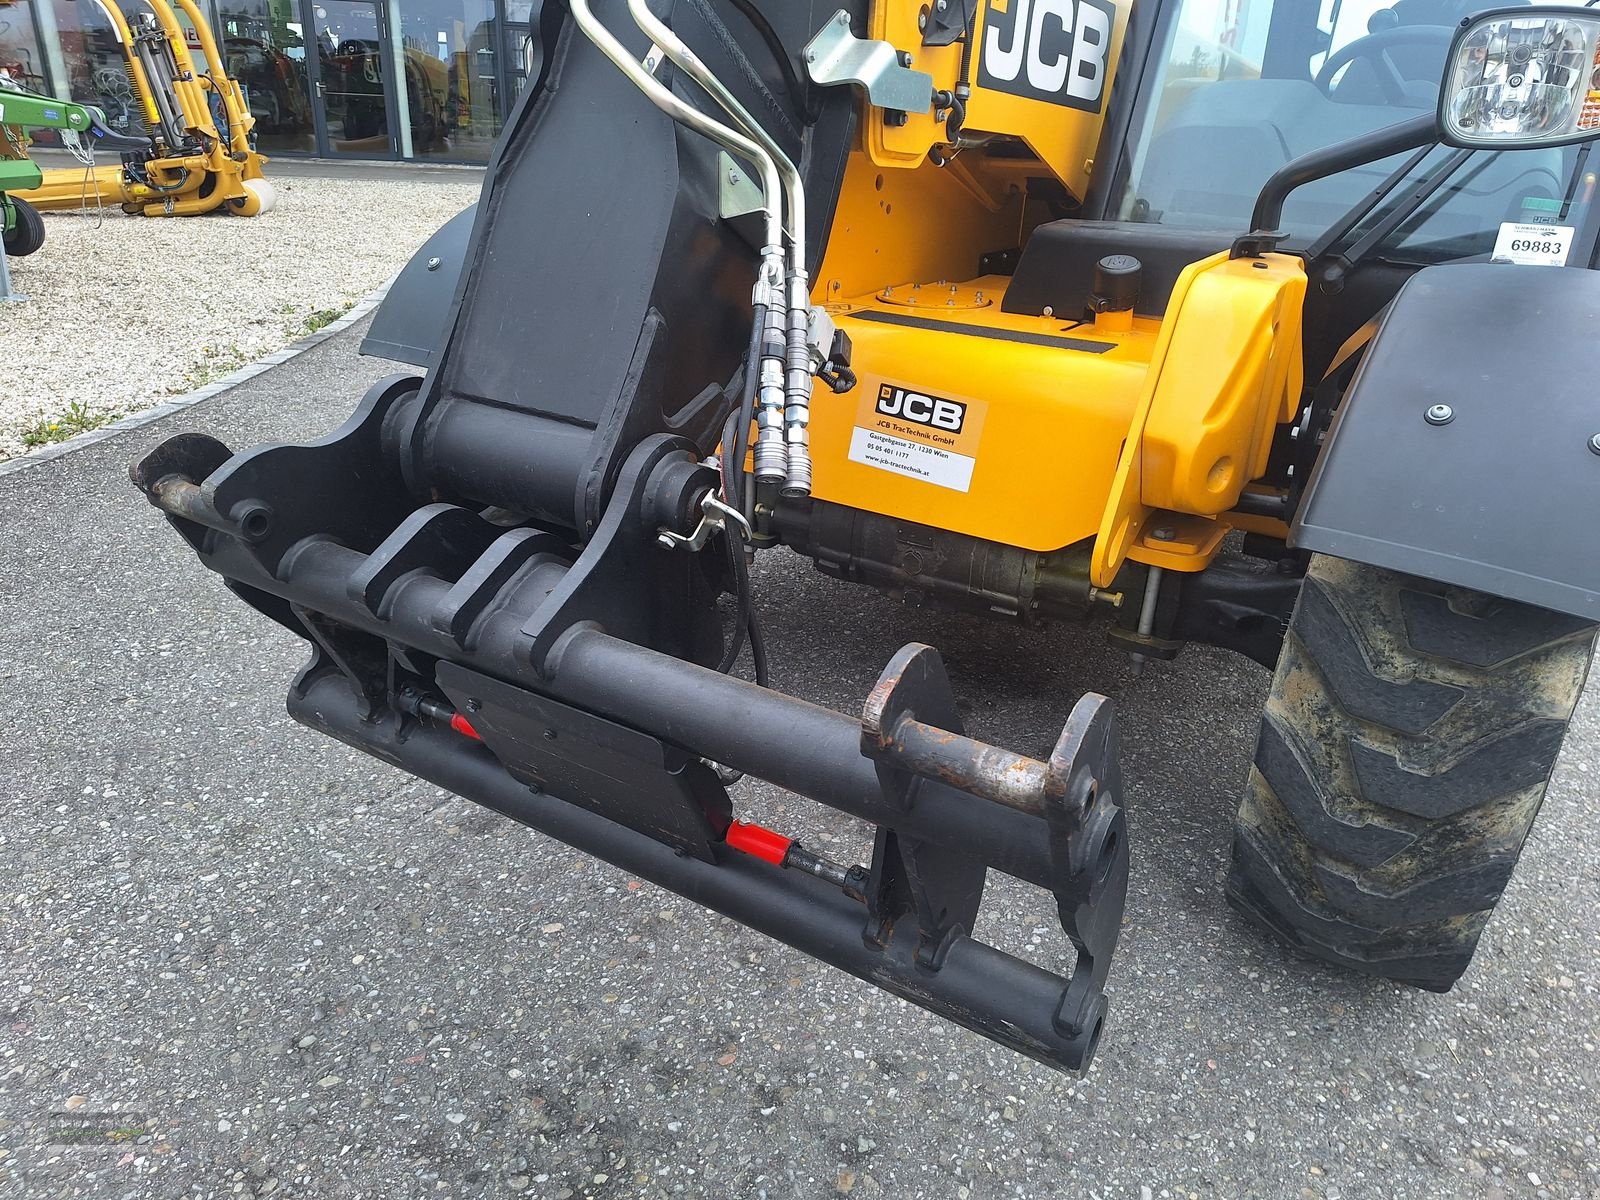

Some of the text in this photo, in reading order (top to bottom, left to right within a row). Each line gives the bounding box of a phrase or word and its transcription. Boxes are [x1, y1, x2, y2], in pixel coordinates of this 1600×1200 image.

[985, 0, 1110, 101] JCB
[1511, 239, 1562, 255] 69883
[878, 389, 963, 430] JCB
[876, 420, 955, 446] JCB TracTechnik GmbH
[867, 442, 875, 450] 05
[883, 447, 894, 455] 401
[895, 450, 909, 459] 1177
[918, 445, 933, 455] 1230
[933, 449, 949, 459] Wien
[865, 454, 930, 477] www.jcb-tractechnik.at
